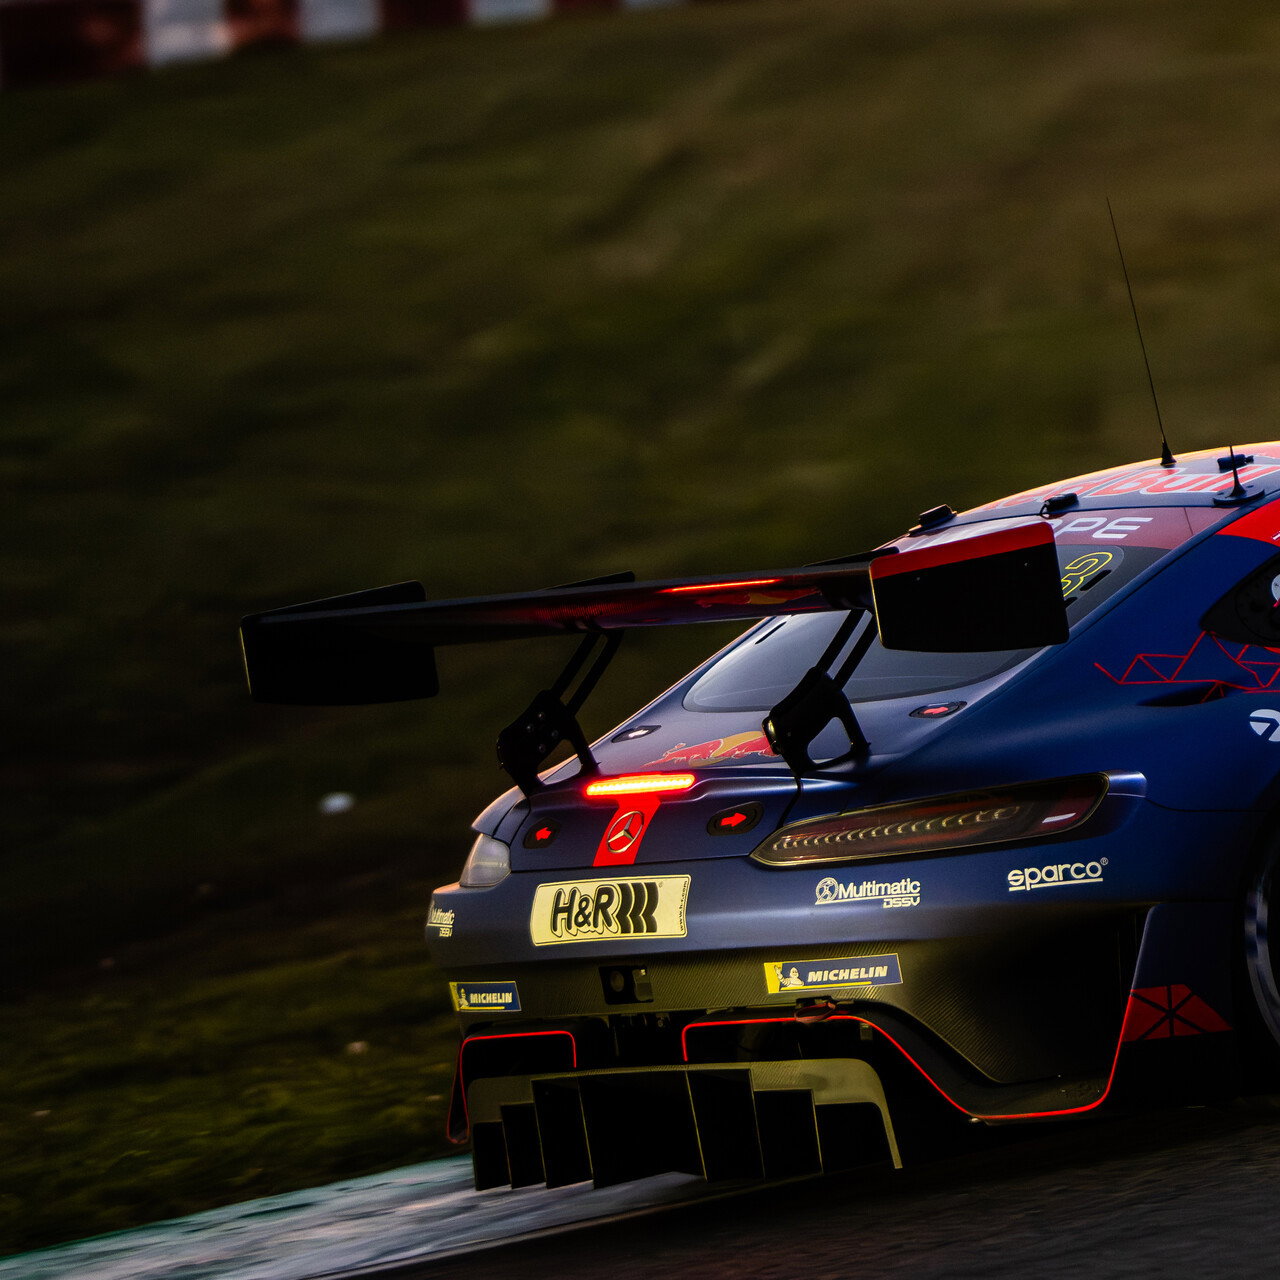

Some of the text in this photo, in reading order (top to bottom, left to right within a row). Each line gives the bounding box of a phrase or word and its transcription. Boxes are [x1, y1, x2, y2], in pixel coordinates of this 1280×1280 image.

[1007, 861, 1103, 891] sparco
[839, 878, 921, 899] Multimatic
[551, 884, 620, 938] H&R
[808, 966, 888, 983] MICHELIN
[470, 992, 513, 1004] MICHELIN
